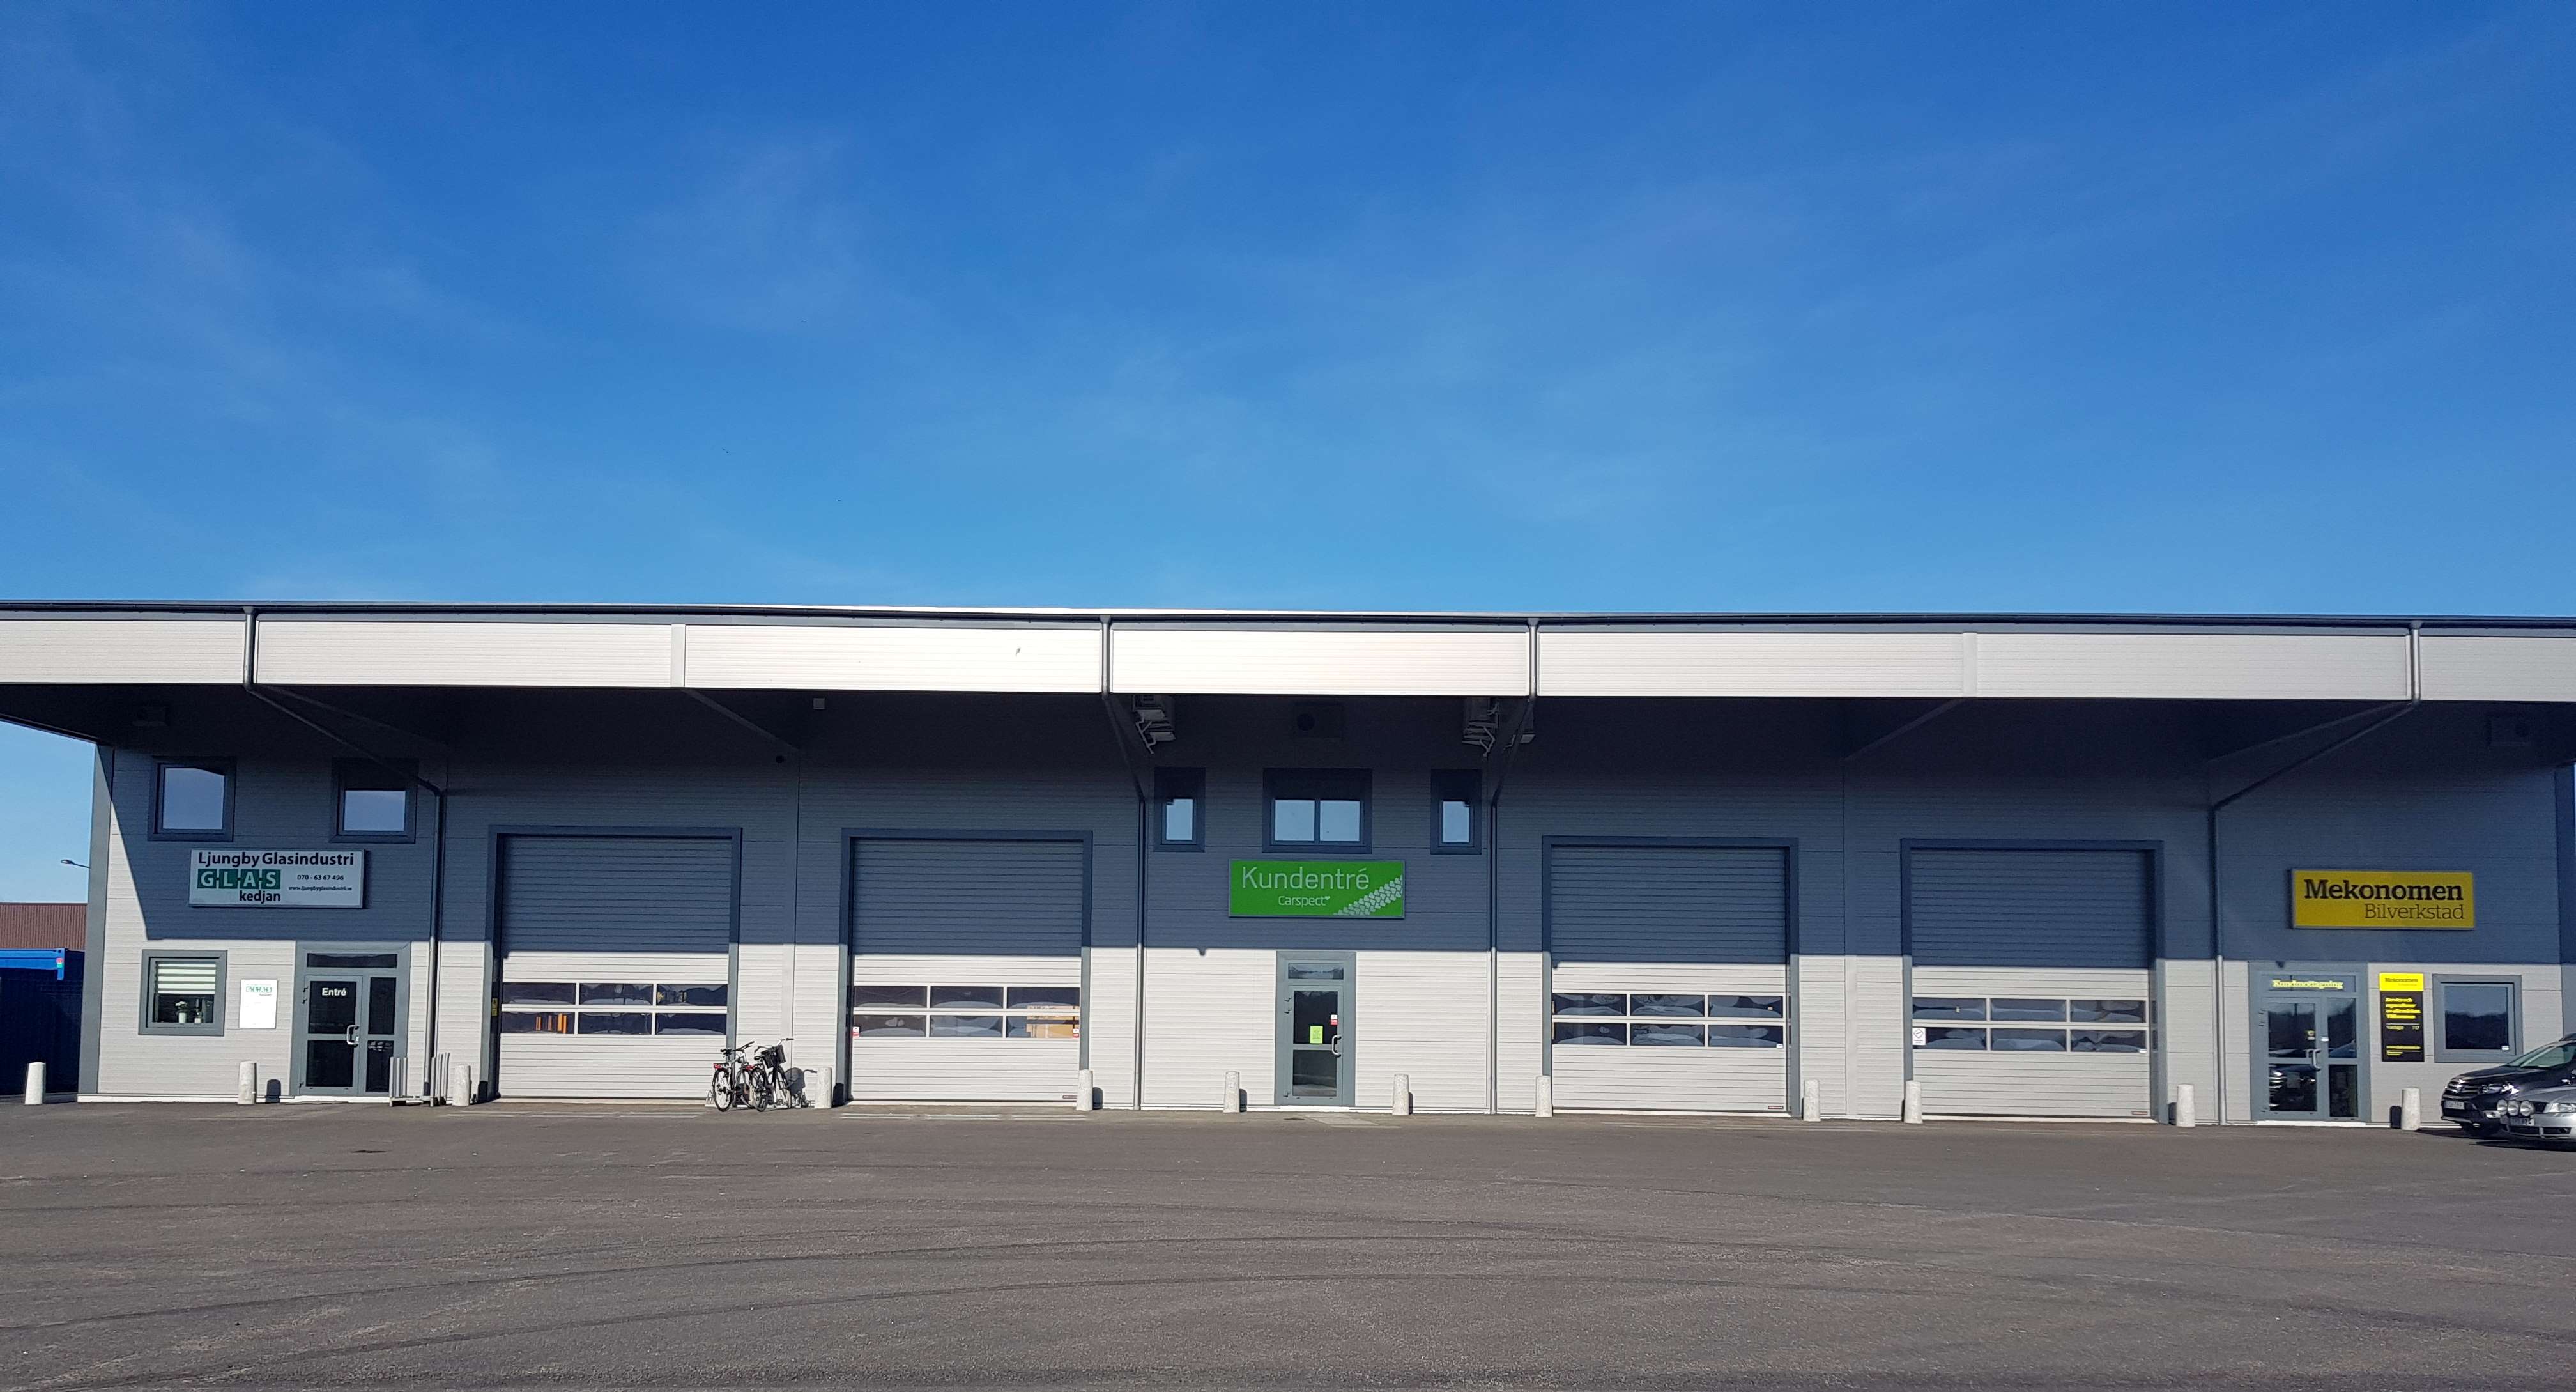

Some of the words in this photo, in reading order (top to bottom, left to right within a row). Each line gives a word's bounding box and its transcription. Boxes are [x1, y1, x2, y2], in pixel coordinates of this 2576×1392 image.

[199, 851, 260, 867] Ljungby
[262, 852, 354, 865] Glasindustri
[1242, 866, 1369, 890] Kundentré
[240, 890, 281, 904] kedjan
[2304, 879, 2464, 901] Mekonomen
[1278, 895, 1326, 908] Carspect
[2364, 903, 2464, 920] Bilverkstad
[321, 987, 346, 996] Entré
